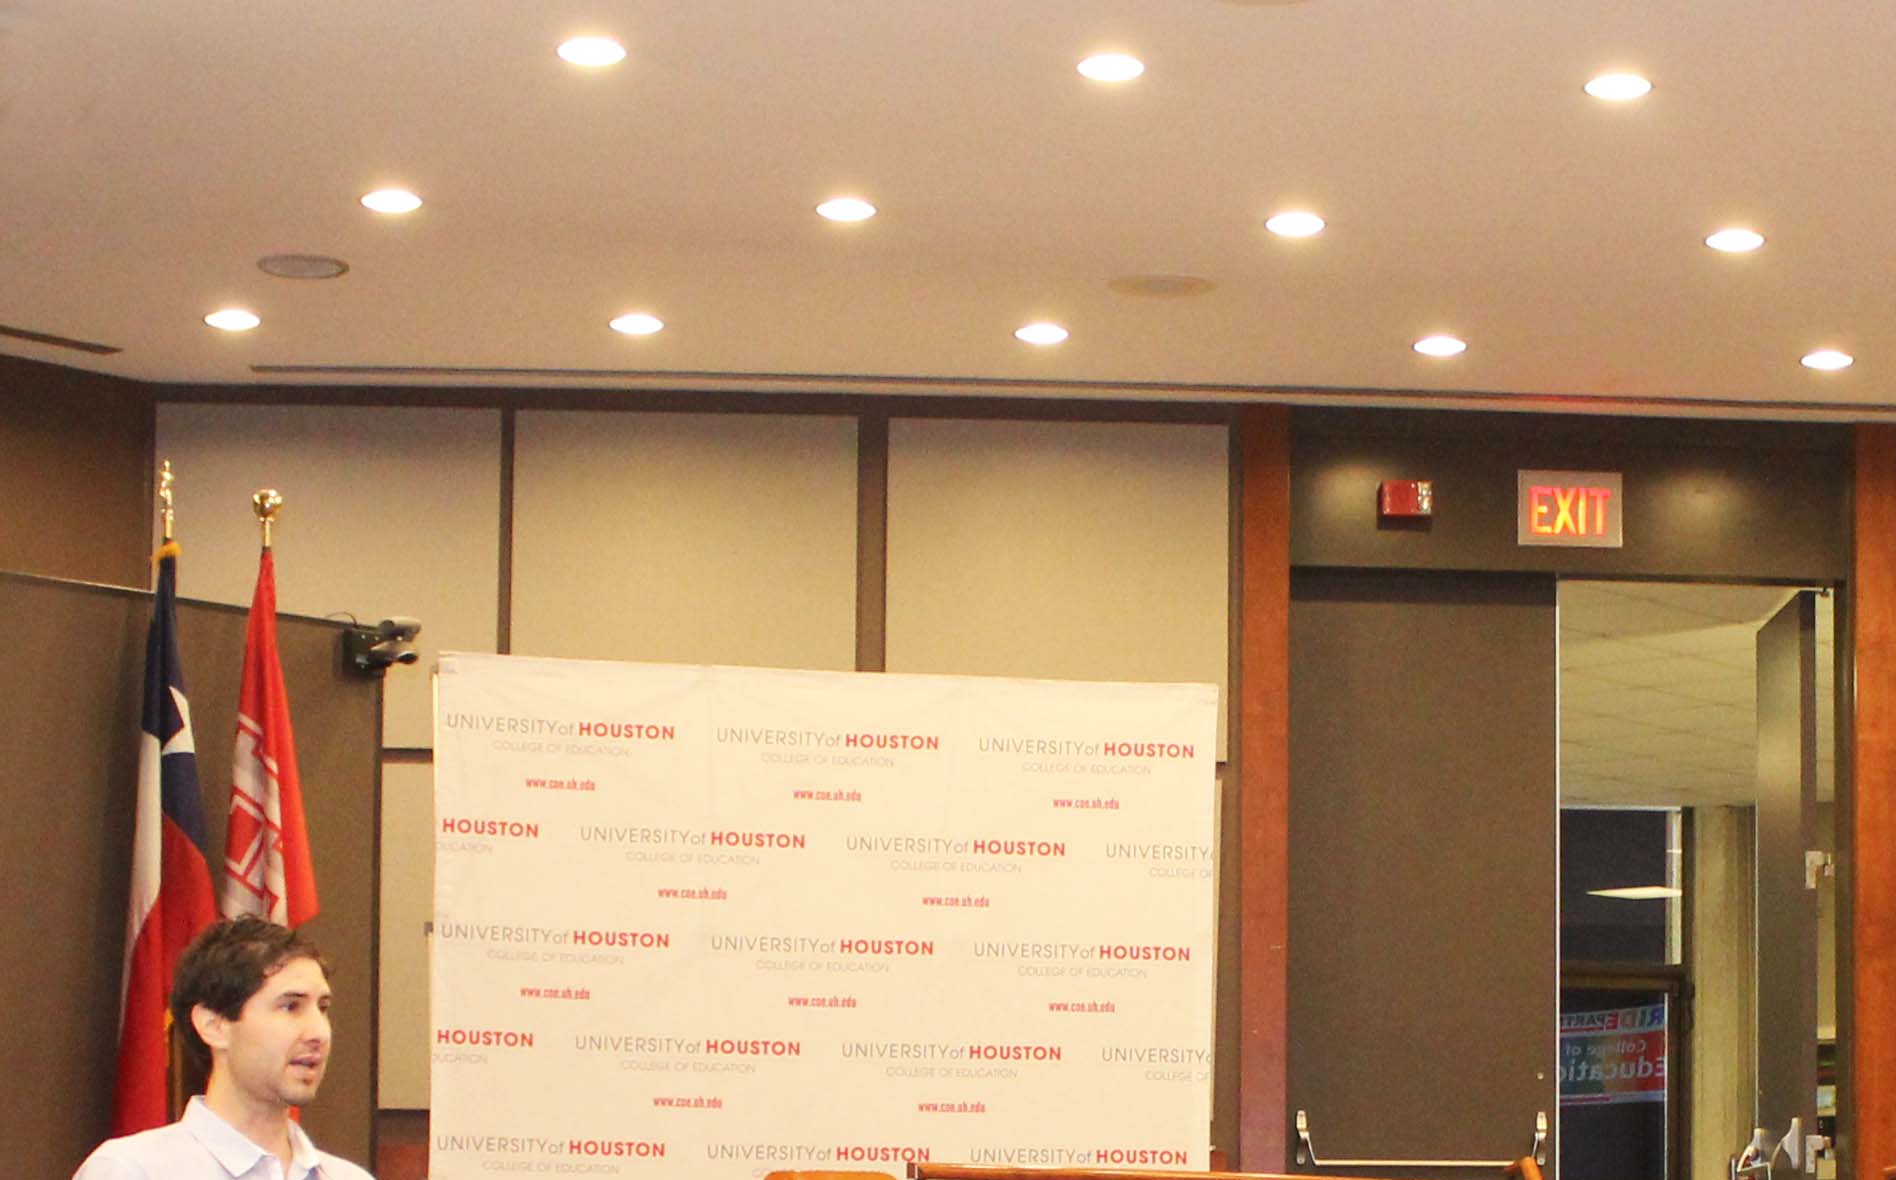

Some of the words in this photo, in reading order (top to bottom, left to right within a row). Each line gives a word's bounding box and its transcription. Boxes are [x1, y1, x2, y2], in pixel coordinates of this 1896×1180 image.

[1529, 486, 1612, 536] EXIT
[578, 722, 675, 741] HOUSTON
[845, 734, 939, 751] HOUSTON
[1104, 742, 1195, 759] HOUSTON
[443, 818, 539, 838] HOUSTON
[710, 831, 805, 849] HOUSTON
[973, 840, 1065, 857] HOUSTON
[572, 930, 669, 948] HOUSTON
[840, 939, 934, 956] HOUSTON
[1100, 945, 1191, 962] HOUSTON
[437, 1030, 534, 1048] HOUSTON
[706, 1040, 800, 1057] HOUSTON
[969, 1045, 1062, 1061] HOUSTON
[569, 1140, 665, 1158] HOUSTON
[836, 1146, 930, 1163] HOUSTON
[1096, 1149, 1187, 1165] HOUSTON
